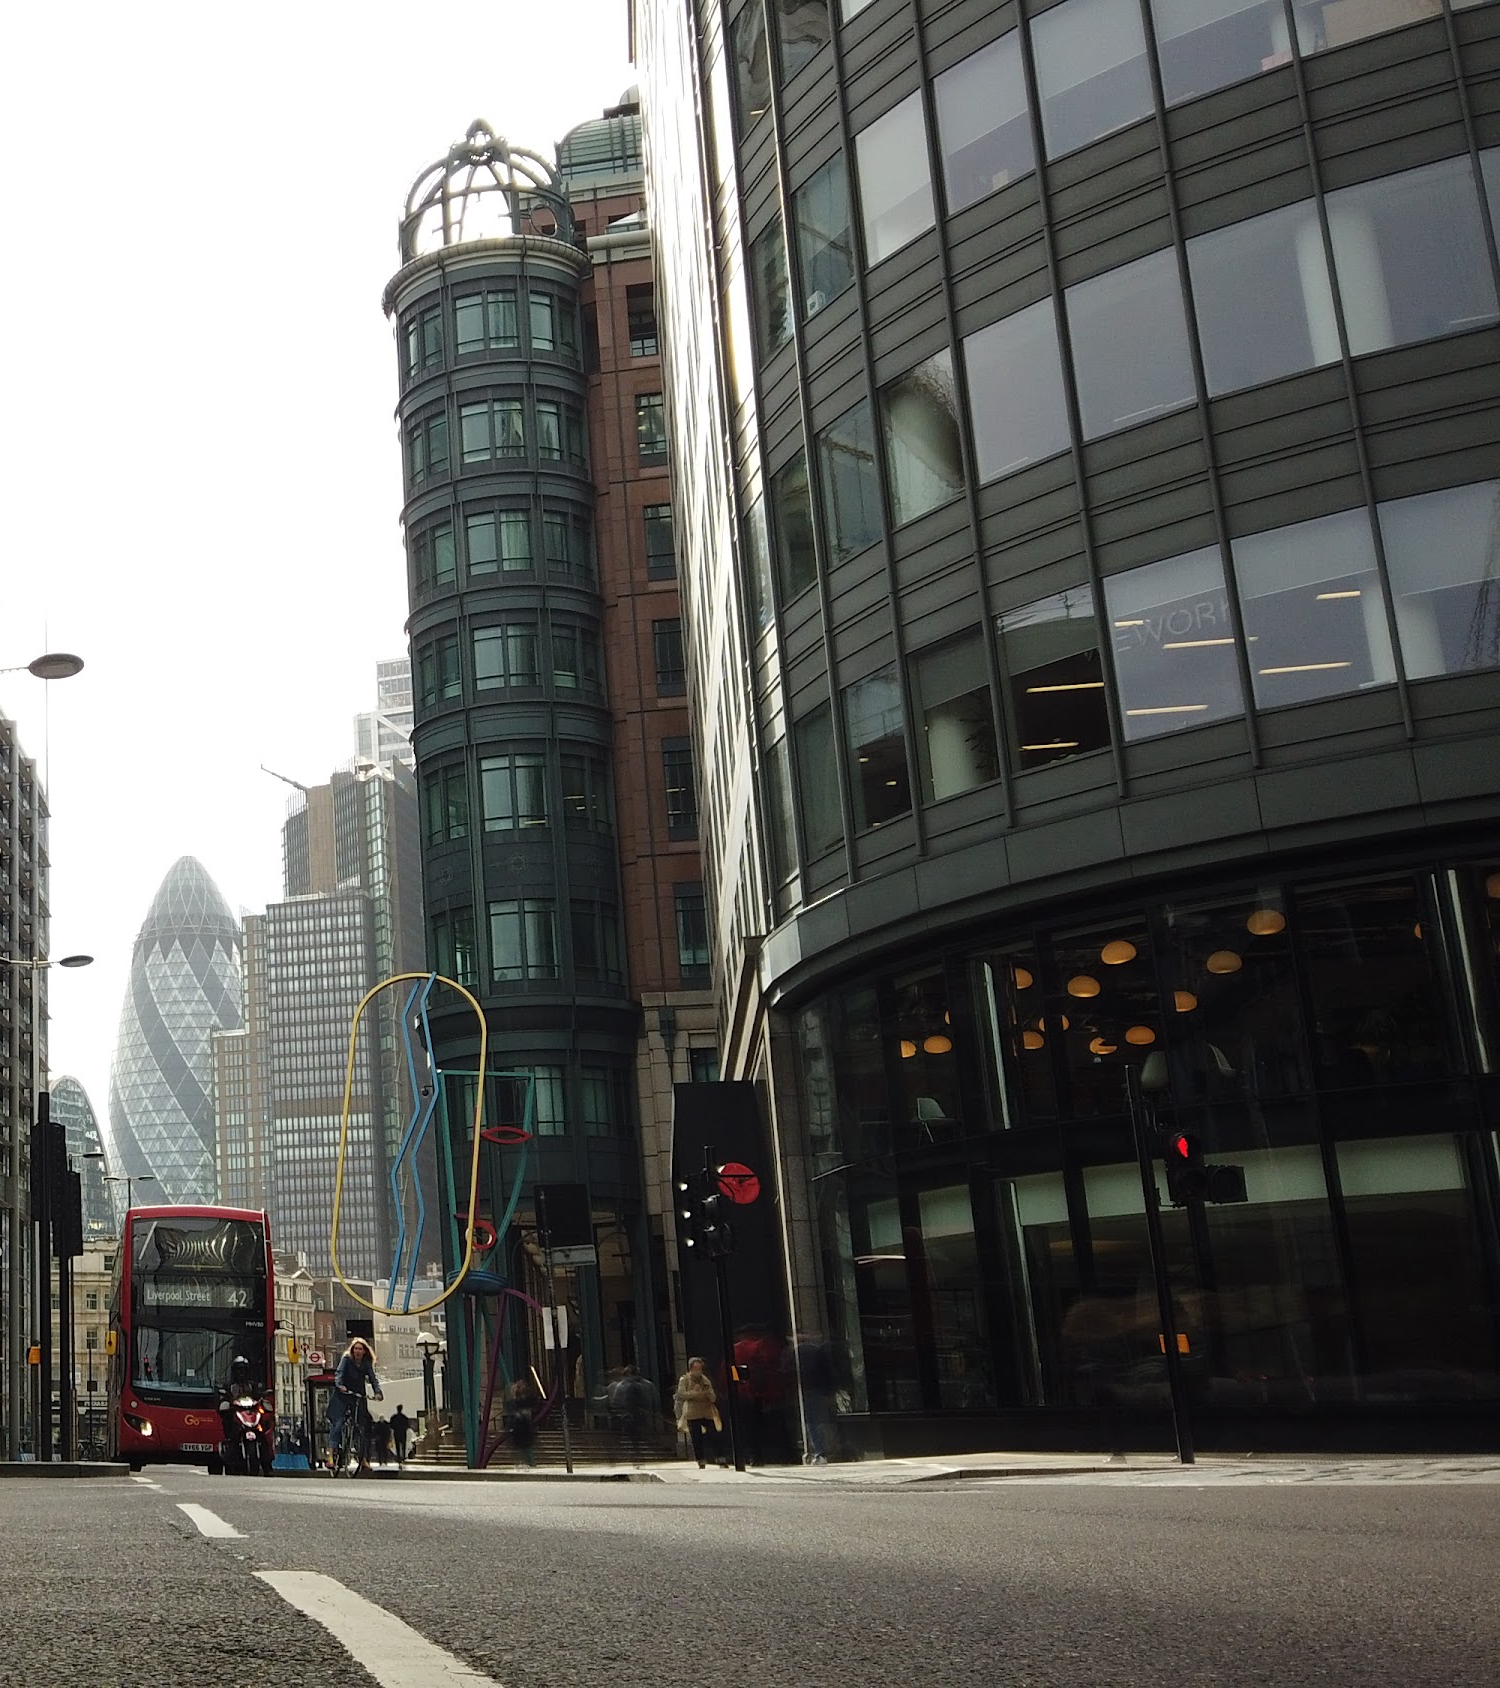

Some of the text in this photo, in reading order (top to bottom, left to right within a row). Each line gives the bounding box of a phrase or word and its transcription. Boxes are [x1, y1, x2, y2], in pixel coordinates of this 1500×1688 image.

[147, 1288, 211, 1303] Liverpool Street
[227, 1290, 247, 1307] 42
[185, 1414, 200, 1426] Go
